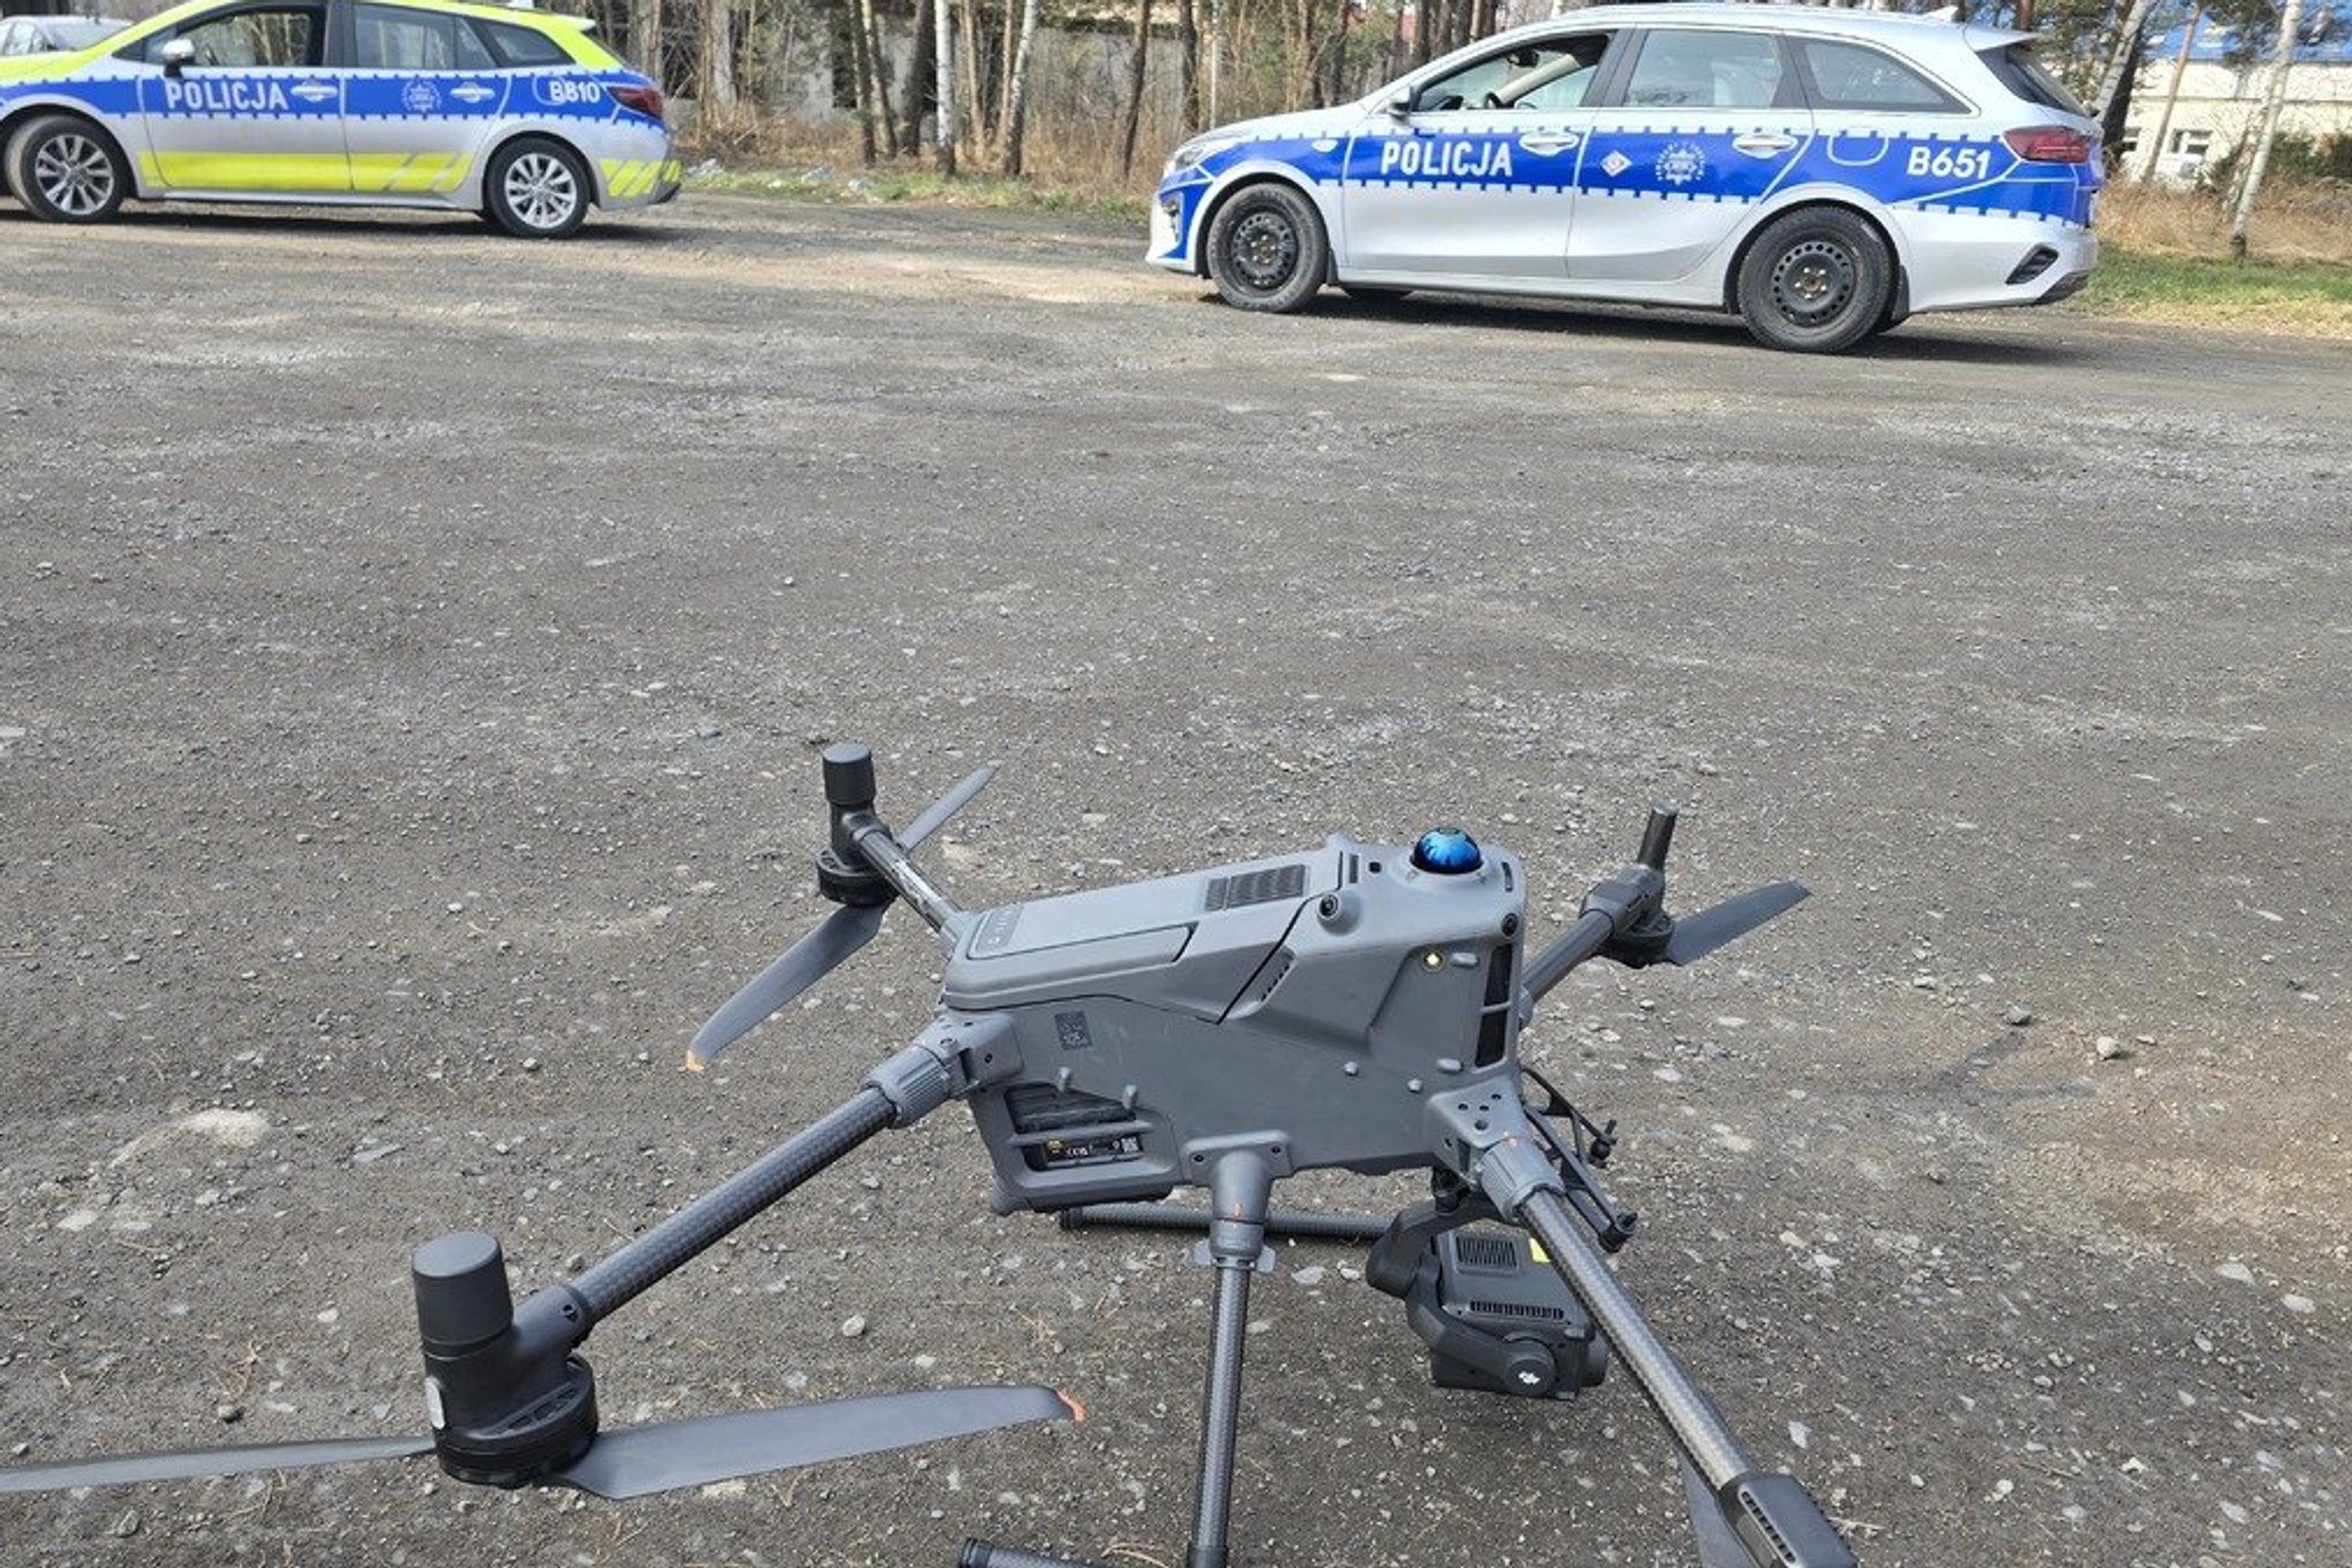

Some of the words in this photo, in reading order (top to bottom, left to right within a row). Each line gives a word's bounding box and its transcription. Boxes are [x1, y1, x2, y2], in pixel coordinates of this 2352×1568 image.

[165, 79, 289, 110] POLICJA
[549, 80, 601, 103] B810
[1381, 141, 1513, 176] POLICJA
[1906, 146, 1991, 179] B651
